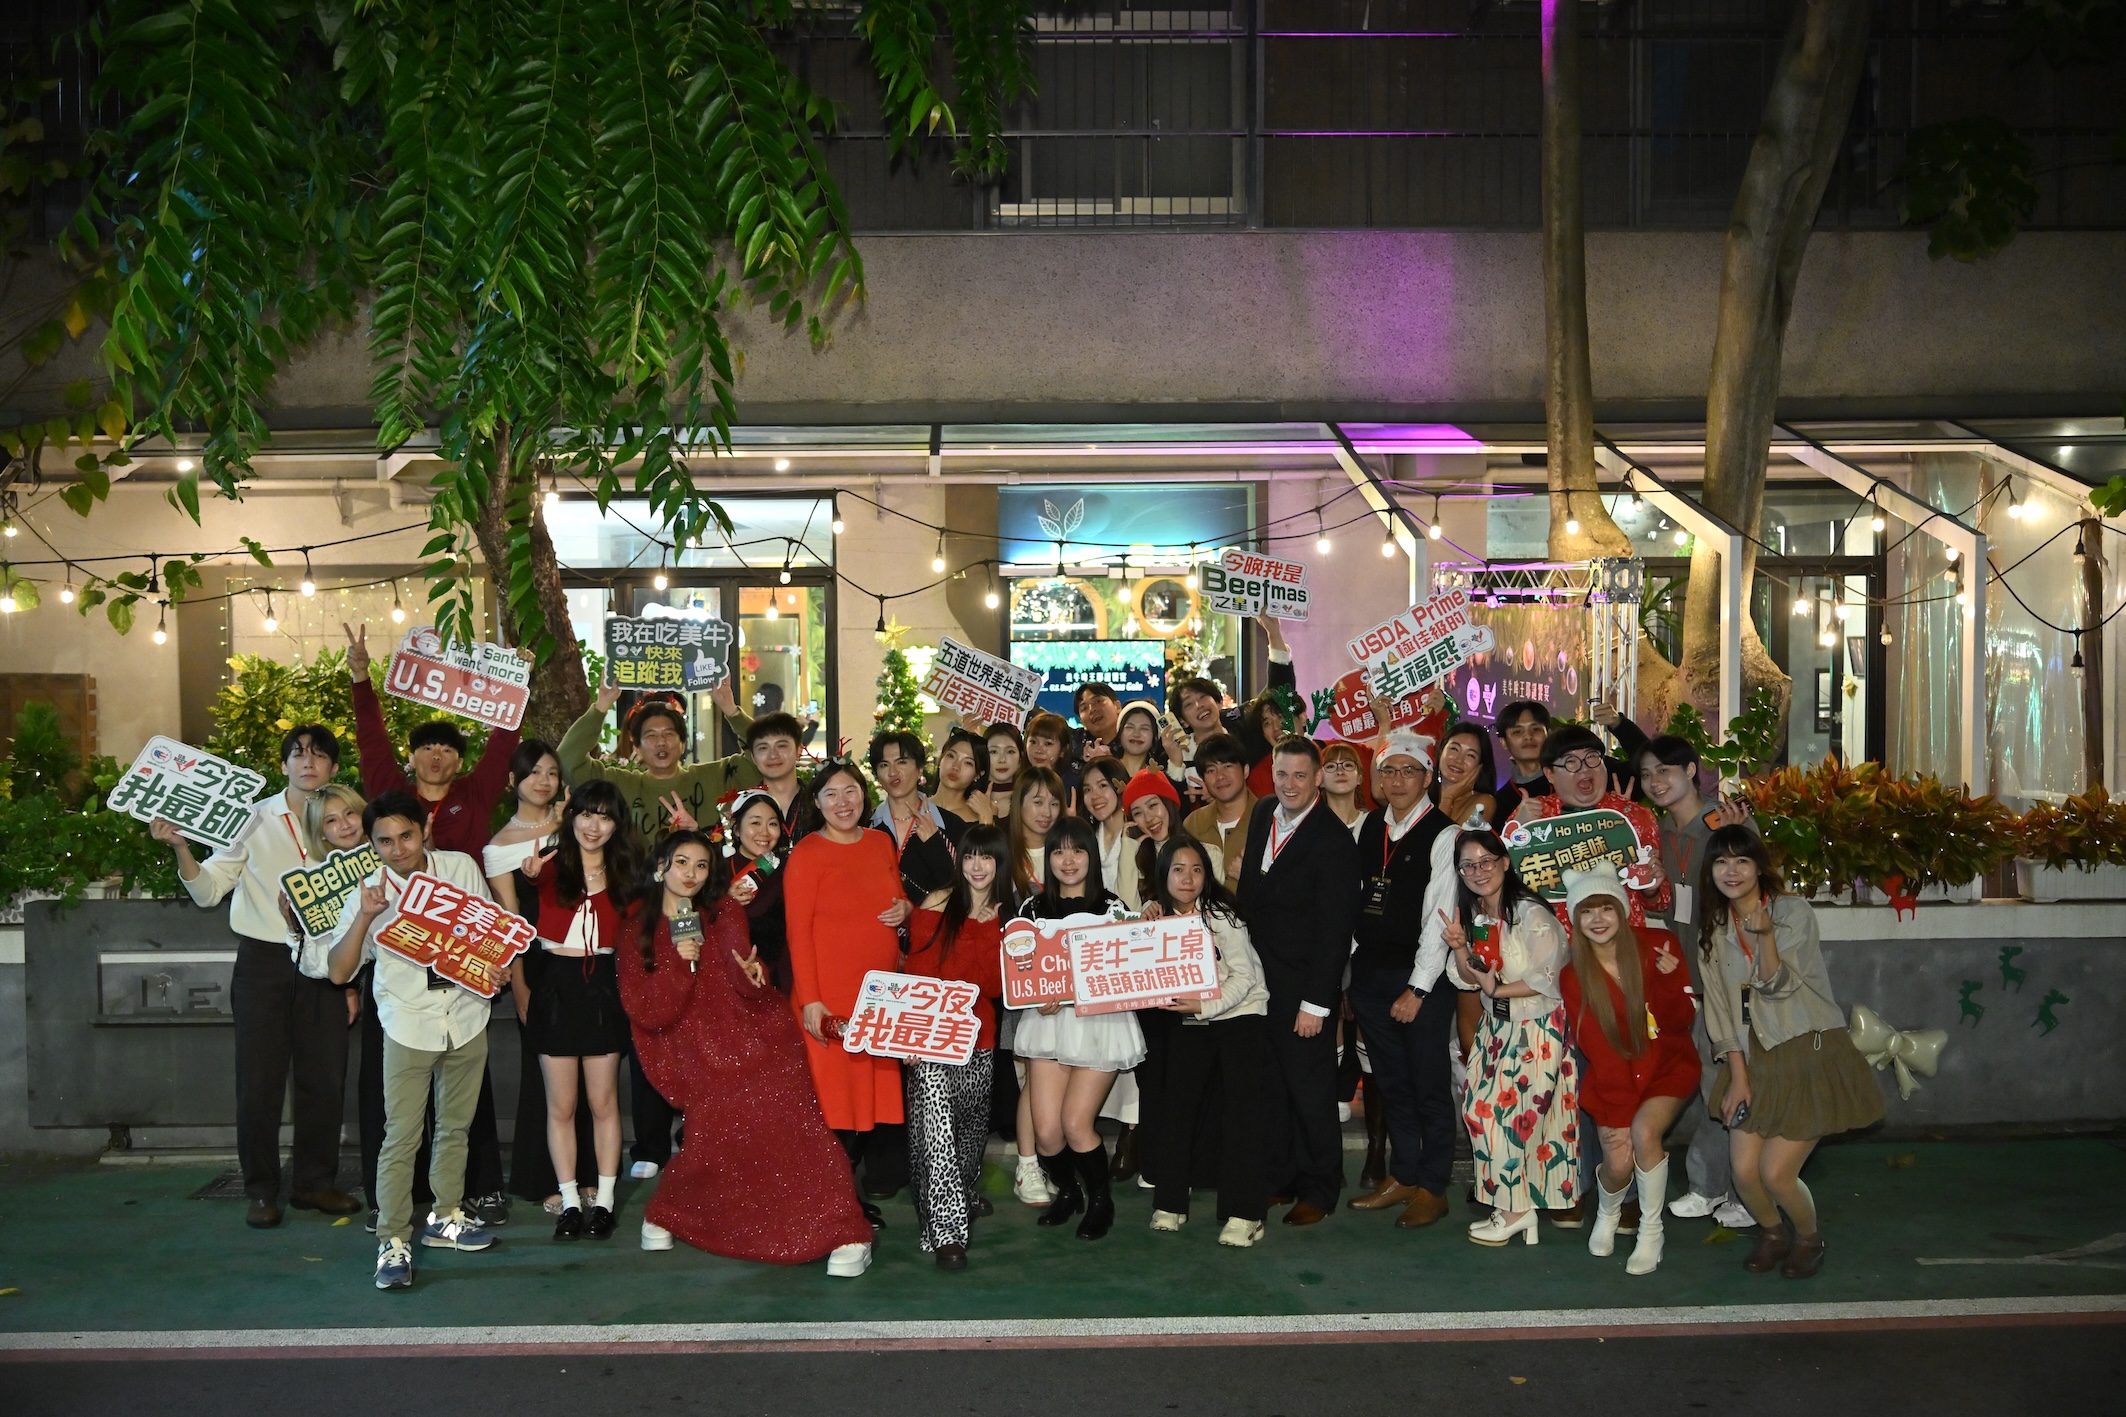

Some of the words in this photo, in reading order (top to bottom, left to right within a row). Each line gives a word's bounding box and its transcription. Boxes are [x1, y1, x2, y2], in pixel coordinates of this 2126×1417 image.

[1202, 566, 1307, 606] Beefmas
[1226, 552, 1303, 585] 今晚我是
[611, 621, 726, 648] 我在吃美牛
[1351, 619, 1410, 661] USDA
[1411, 589, 1465, 628] Prime
[1395, 611, 1467, 659] 極佳級的
[454, 655, 482, 671] want
[487, 665, 525, 683] more
[483, 648, 526, 668] Santa
[645, 645, 683, 661] 快來
[695, 664, 713, 673] LIKE
[1374, 635, 1461, 699] 幸福感
[394, 659, 449, 703] U.S.
[451, 687, 517, 724] beef!
[613, 660, 683, 686] 追蹤我
[687, 676, 716, 687] Follow
[936, 641, 1033, 706] 五道世界美牛風味
[192, 759, 261, 804] 今夜
[113, 773, 251, 839] 我最帥
[1555, 824, 1572, 838] Ho
[1576, 821, 1593, 835] Ho
[402, 878, 531, 948] 吃美牛
[381, 918, 492, 992] 星光感
[1080, 928, 1204, 973] 美牛一上桌
[910, 981, 974, 1016] 今夜
[1011, 978, 1037, 998] U.S.
[1039, 976, 1067, 996] Beef
[1085, 962, 1205, 998] 鏡頭就開拍
[849, 1007, 976, 1053] 我最美
